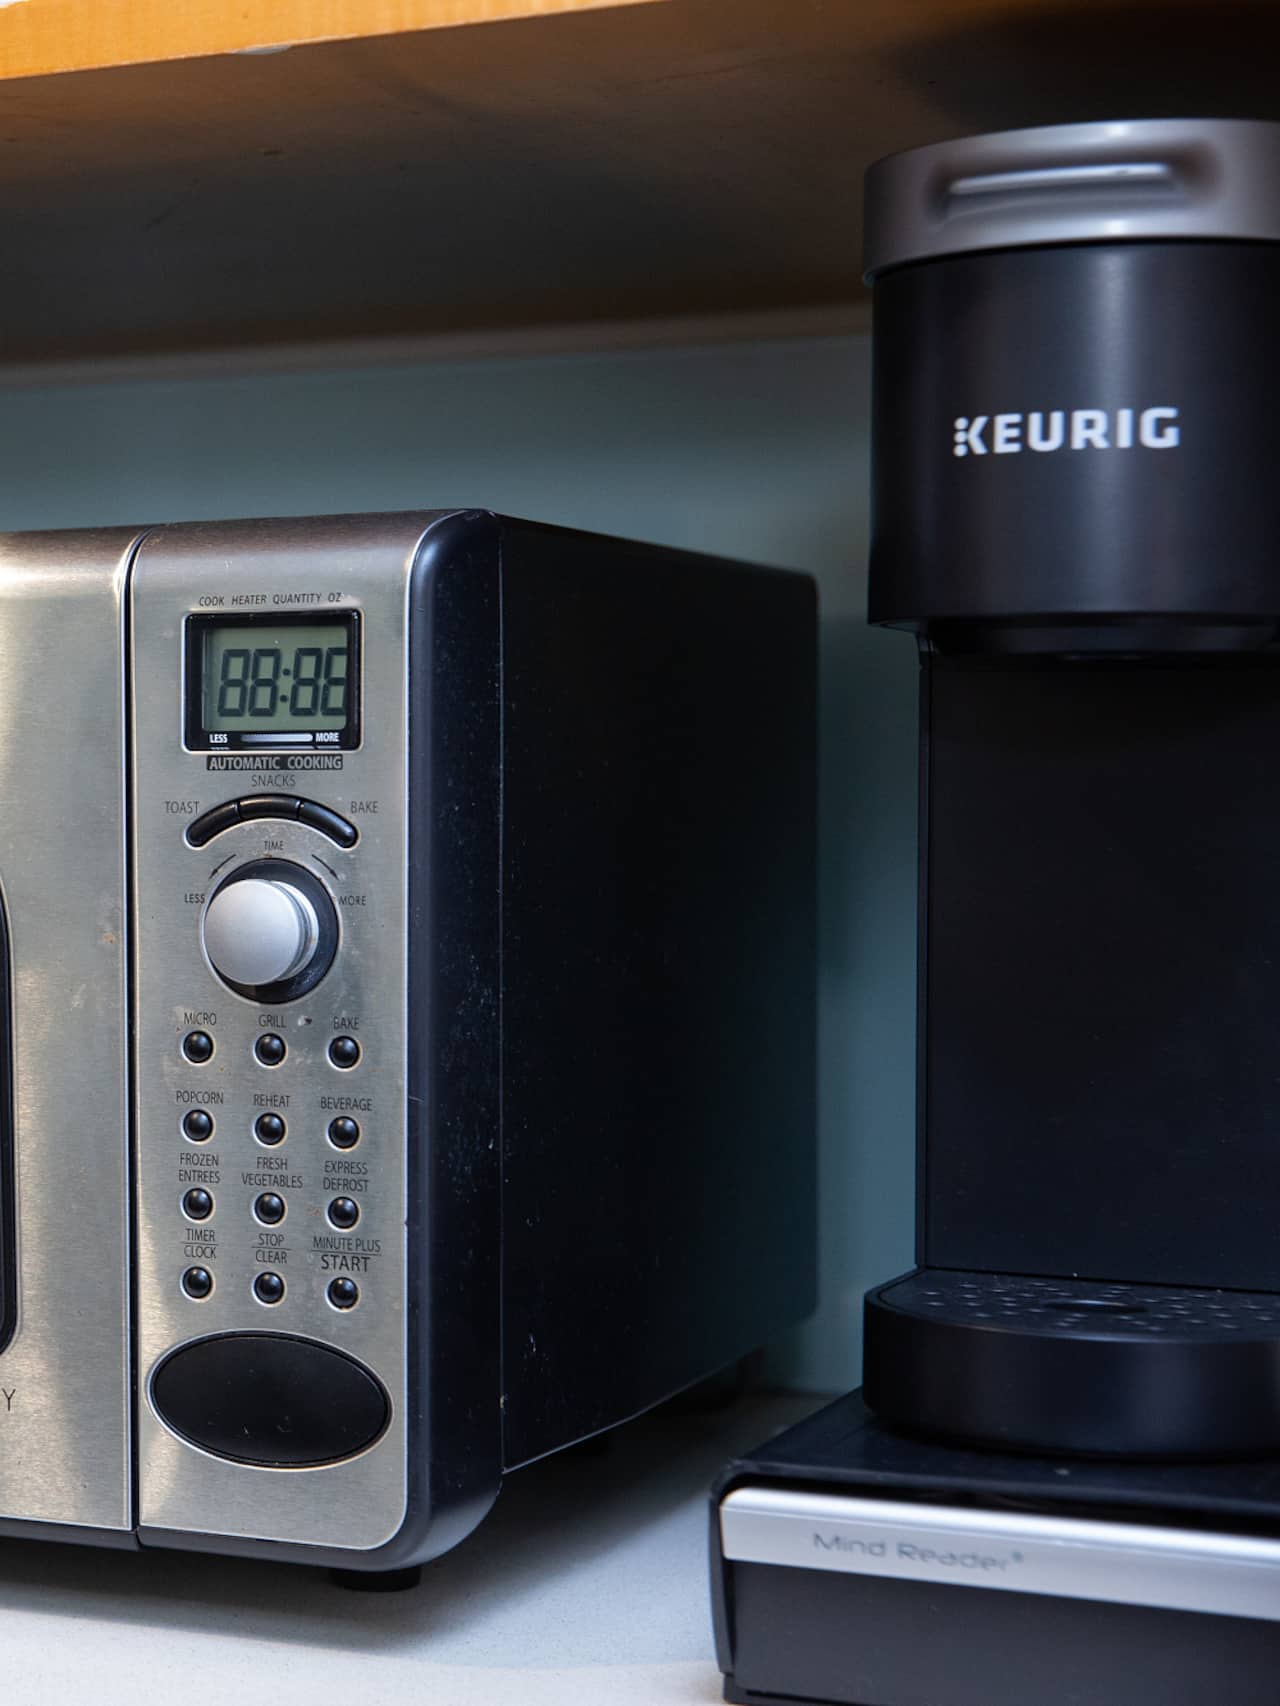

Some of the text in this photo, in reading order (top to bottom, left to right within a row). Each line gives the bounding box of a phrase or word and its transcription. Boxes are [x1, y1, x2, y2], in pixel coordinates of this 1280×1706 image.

[953, 406, 1180, 457] KEURIG
[199, 596, 225, 607] COOK
[231, 594, 267, 605] HEATER
[272, 593, 321, 604] QUANTITY
[209, 733, 228, 744] LESS
[315, 732, 339, 742] MORE
[208, 755, 342, 770] AUTOMATIC COOKING
[251, 775, 296, 787] SNACKS
[165, 801, 200, 814] TOAST
[350, 801, 378, 814] BAKE
[264, 840, 284, 851] TIME
[184, 893, 205, 904] LESS
[339, 895, 367, 906] MORE
[184, 1012, 217, 1025] MICRO
[258, 1015, 286, 1028] GRILL
[333, 1016, 360, 1030] BAKE
[176, 1091, 224, 1104] POPCORN
[253, 1094, 290, 1107] REHEAT
[320, 1097, 372, 1111] BEVERAGE
[180, 1153, 219, 1166] FROZEN
[256, 1157, 288, 1170] FRESH
[324, 1160, 368, 1175] EXPRESS
[179, 1170, 220, 1184] ENTREES
[242, 1173, 303, 1188] VEGETABLES
[323, 1177, 369, 1192] DEFROST
[185, 1228, 215, 1241] TIMER
[258, 1233, 284, 1246] STOP
[313, 1236, 382, 1252] MINUTE PLUS
[184, 1246, 216, 1259] CLOCK
[255, 1250, 287, 1264] CLEAR
[321, 1254, 371, 1272] START
[813, 1532, 886, 1557] Mind
